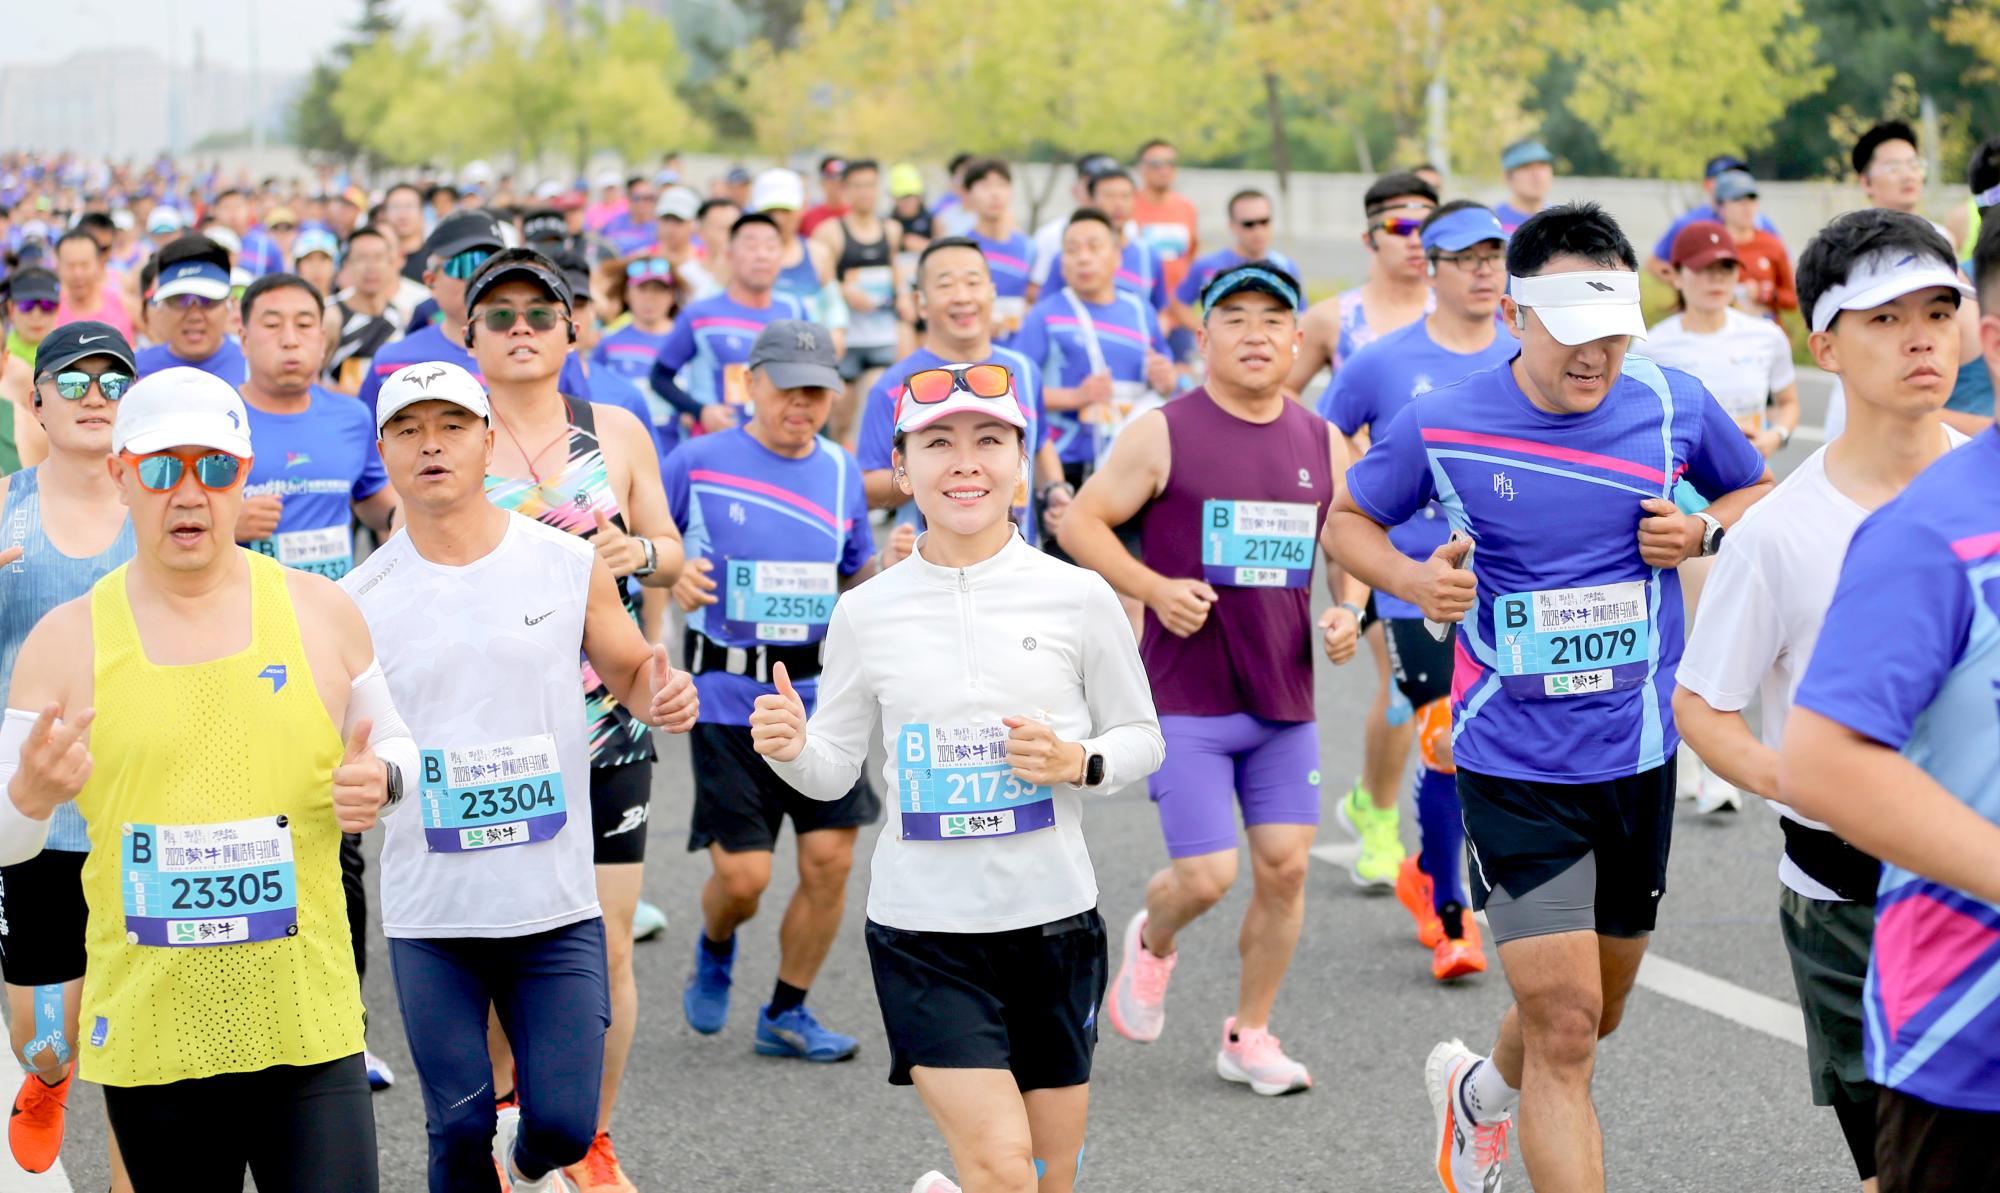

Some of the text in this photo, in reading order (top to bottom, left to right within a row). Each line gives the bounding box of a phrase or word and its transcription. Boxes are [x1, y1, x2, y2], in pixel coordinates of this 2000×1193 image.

[1214, 507, 1229, 528] B
[1245, 539, 1305, 562] 21746
[736, 567, 751, 586] B
[765, 597, 827, 618] 23516
[1505, 600, 1528, 629] B
[1550, 628, 1637, 665] 21079
[1572, 674, 1602, 690] 蒙牛
[906, 731, 926, 762] B
[937, 740, 1008, 763] 2026蒙牛呼和
[424, 756, 442, 783] B
[459, 780, 555, 820] 23304
[487, 826, 518, 843] 蒙牛
[969, 815, 1003, 832] 蒙牛
[133, 831, 152, 864] B
[171, 870, 283, 909] 23305
[199, 922, 236, 940] 蒙牛
